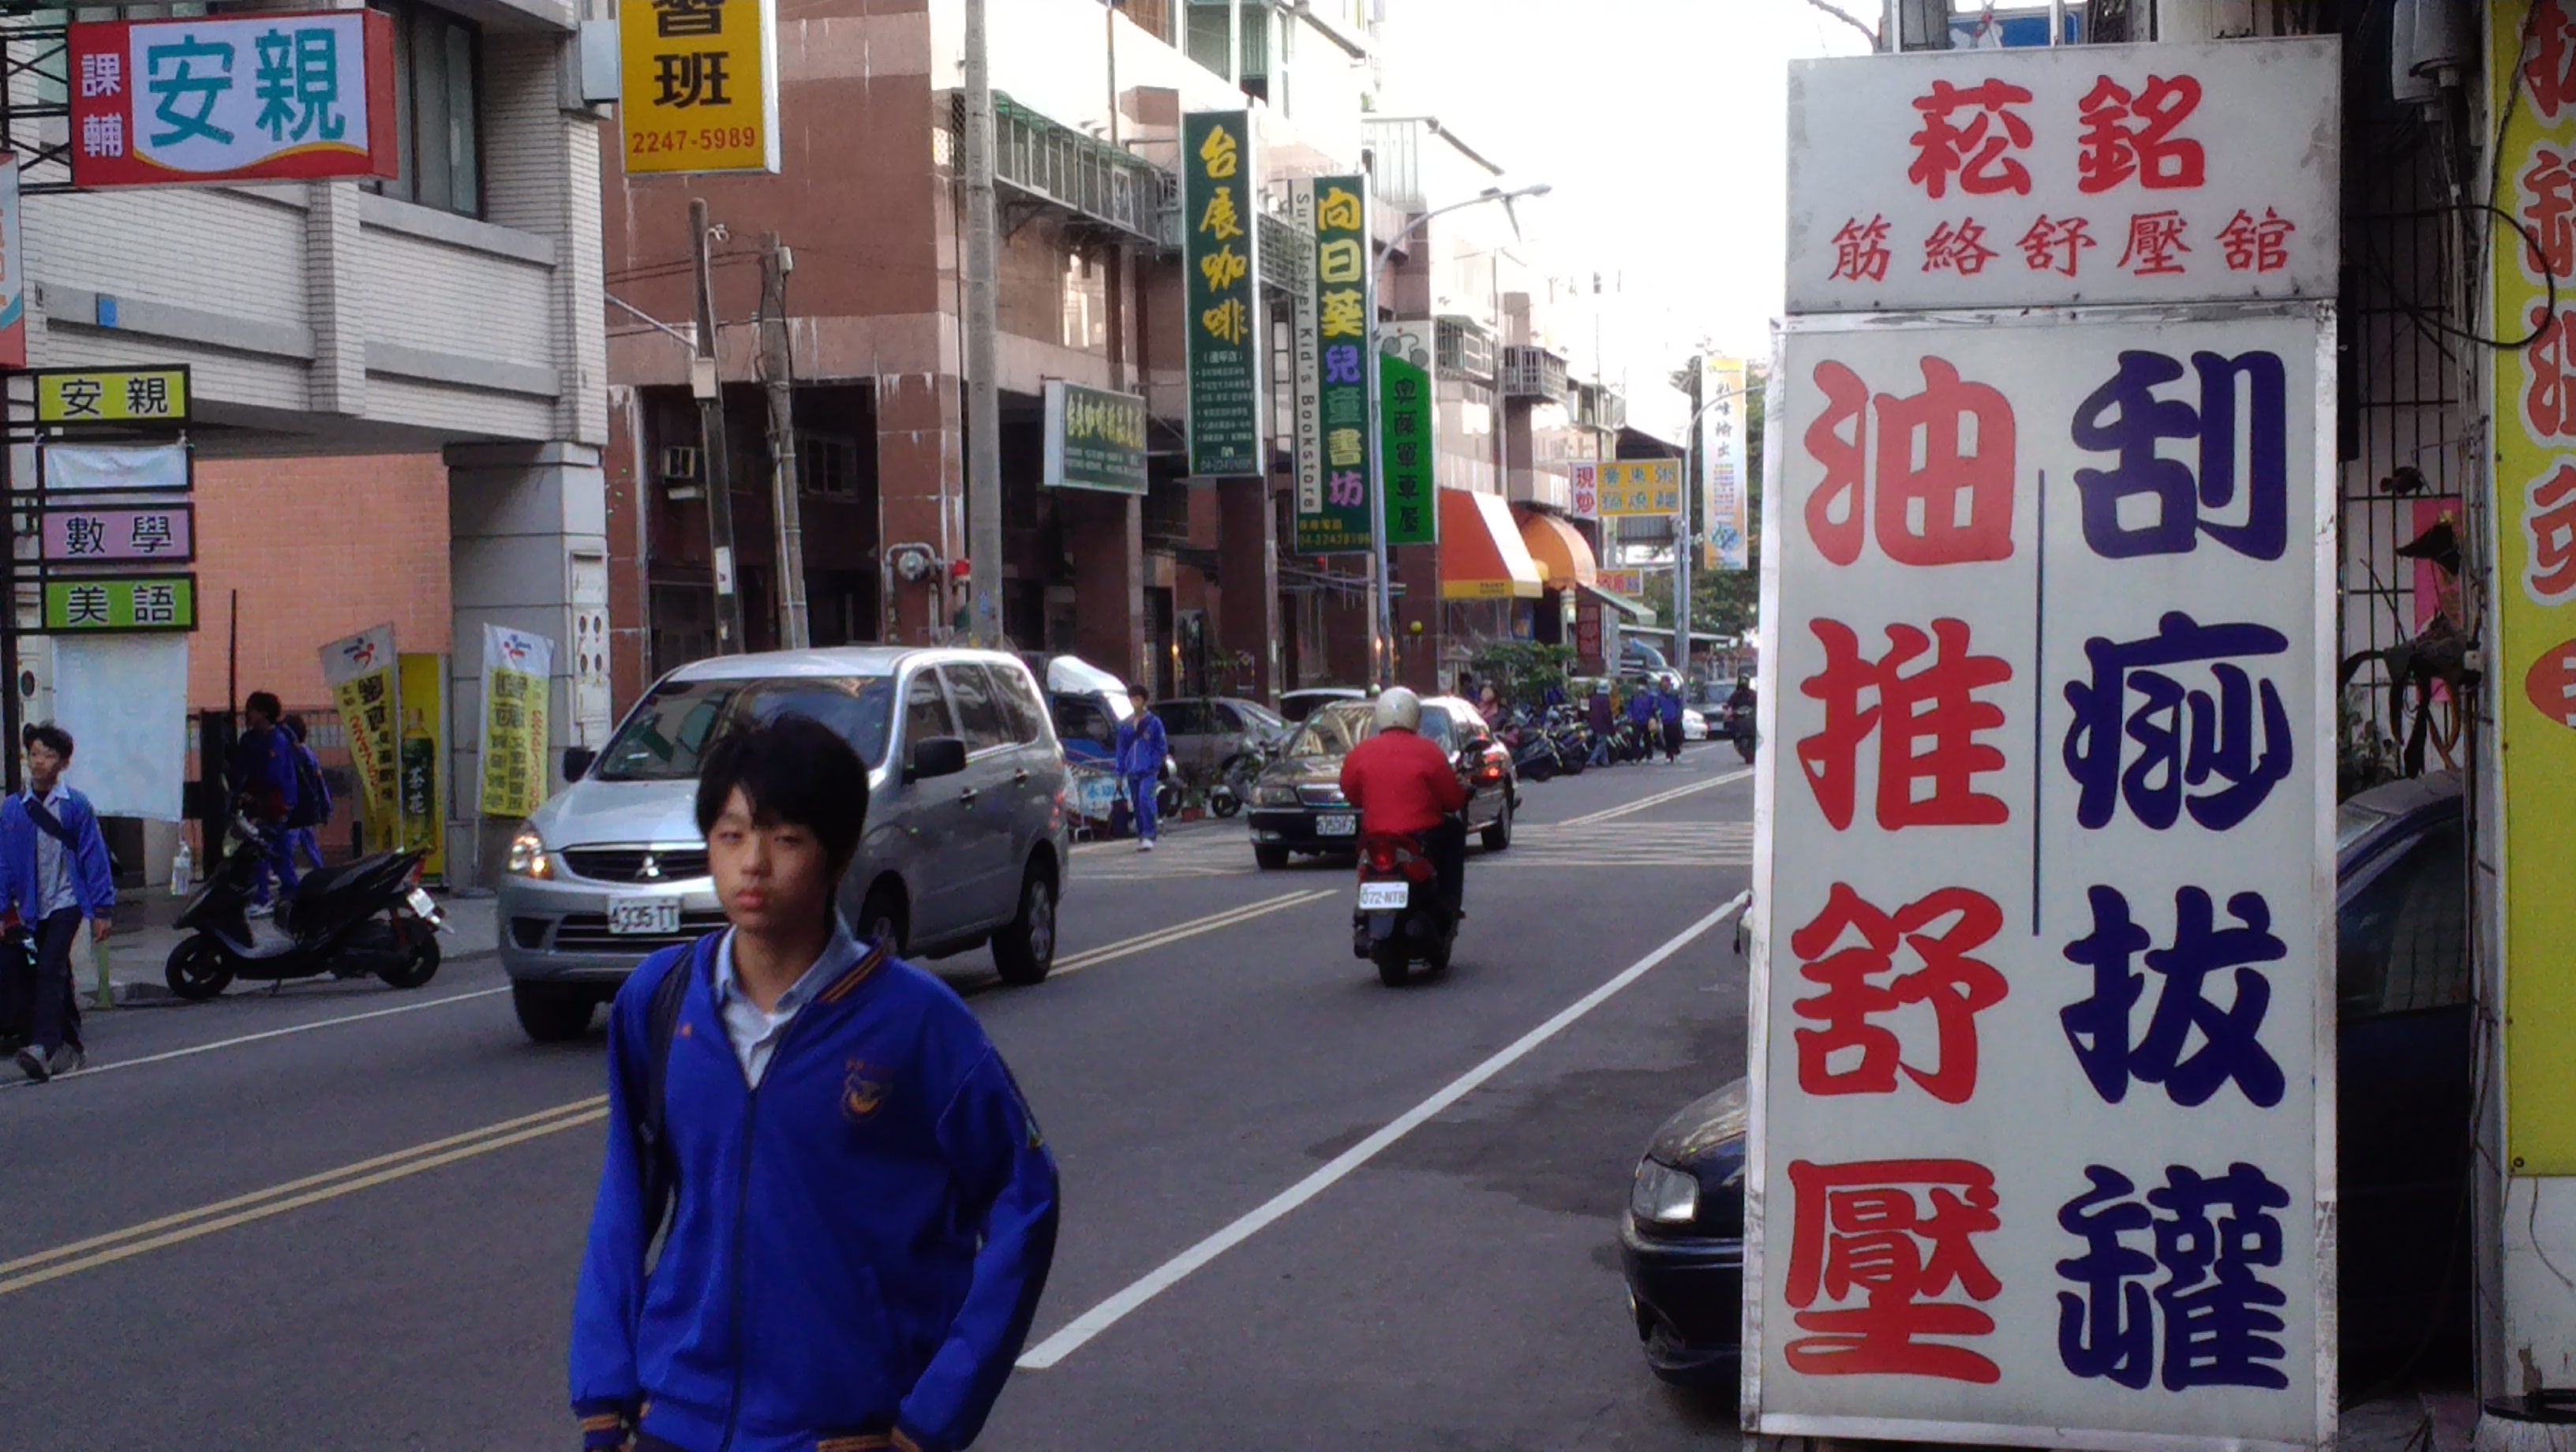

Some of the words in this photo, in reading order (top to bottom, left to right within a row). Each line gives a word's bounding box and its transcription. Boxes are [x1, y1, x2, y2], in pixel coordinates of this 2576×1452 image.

[81, 53, 123, 158] 課輔
[147, 28, 347, 148] 安親
[632, 126, 755, 153] 2247-5989
[1907, 74, 2205, 200] 菘銘
[1199, 124, 1249, 344] 台展咖啡
[61, 377, 168, 416] 安親
[1300, 327, 1313, 384] Kid's
[1317, 186, 1365, 507] 向日葵兒童書坊
[1300, 395, 1315, 510] Bookstore
[66, 516, 171, 554] 數學
[68, 586, 174, 623] 美語
[1784, 354, 2016, 1383] 油推舒壓
[2057, 350, 2292, 1390] 刮痧拔罐
